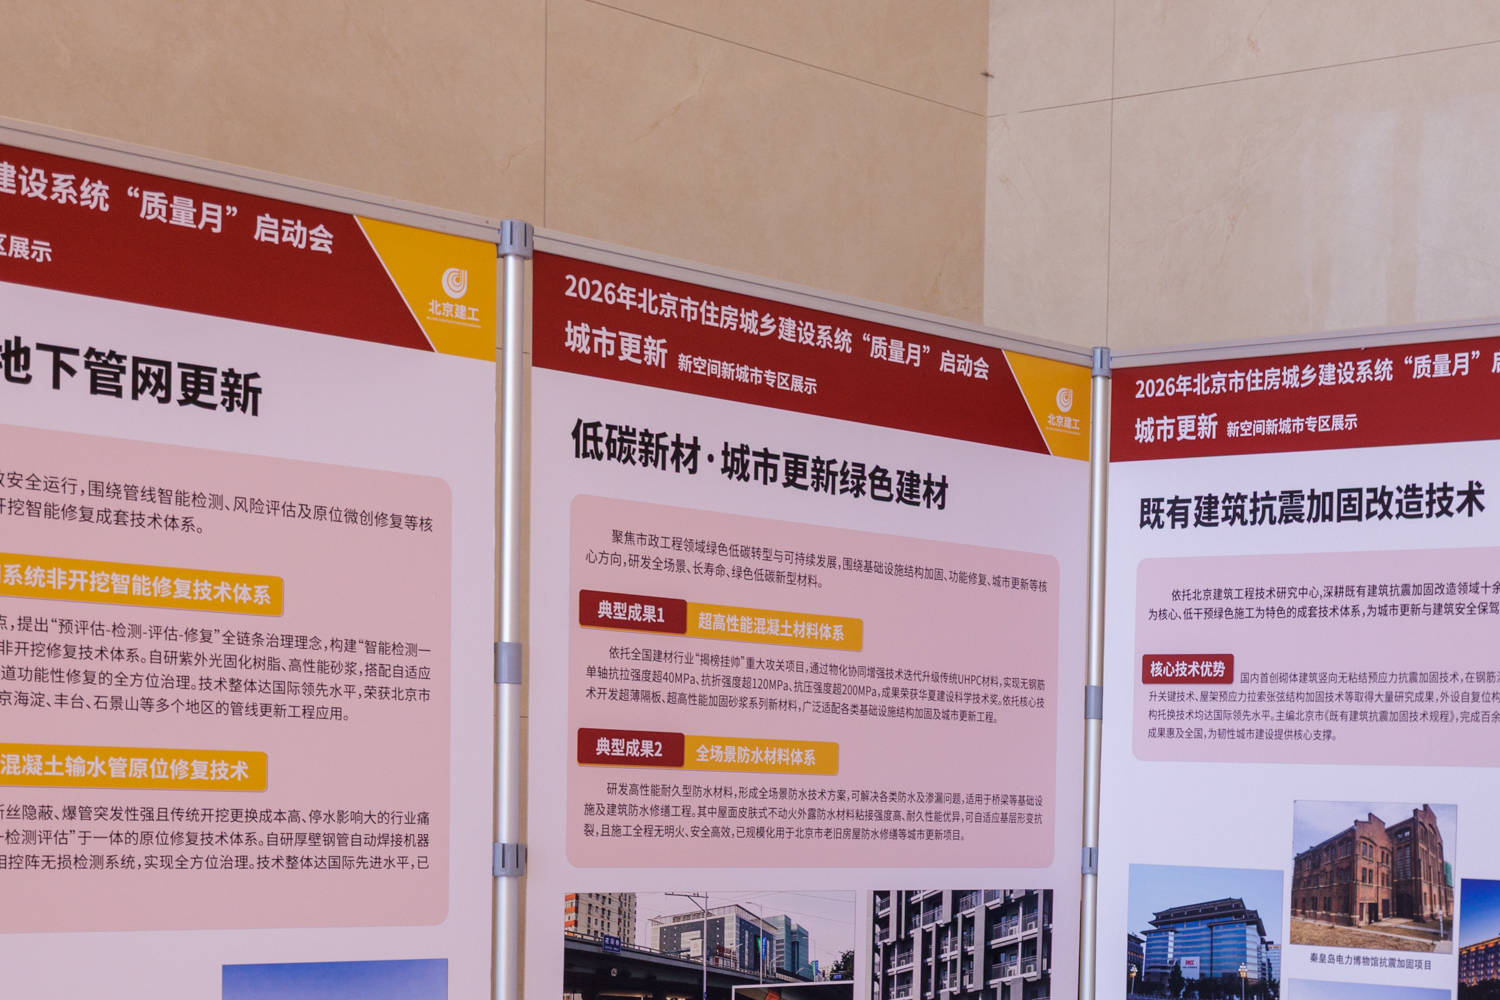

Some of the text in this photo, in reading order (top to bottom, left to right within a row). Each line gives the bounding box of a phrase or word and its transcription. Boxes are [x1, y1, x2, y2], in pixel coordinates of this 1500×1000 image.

[428, 299, 480, 322] 北京建工
[565, 274, 990, 381] 2026年北京市住房城乡建设系统“质量月”启动会
[565, 320, 818, 395] 城市更新 新空间新城市专区展示
[0, 336, 262, 416] 地下管网更新
[1047, 413, 1081, 431] 北京建工
[1135, 412, 1358, 444] 城市更新 新空间新城市专区展示
[571, 418, 948, 511] 低碳新材·城市更新绿色建材
[0, 471, 433, 533] 安全运行，围绕管线智能检测、风险评估及原位微创修复等核
[1139, 480, 1486, 531] 既有建筑抗震加固改造技术
[0, 563, 271, 606] 系统非开挖智能修复技术体系
[598, 600, 665, 623] 典型成果1
[698, 612, 844, 641] 超高性能混凝土材料体系
[1150, 660, 1226, 678] 核心技术优势
[596, 737, 663, 757] 典型成果2
[696, 744, 816, 766] 全场景防水材料体系
[1, 753, 249, 782] 混凝土输水管原位修复技术
[1310, 952, 1432, 970] 秦皇岛电力博物馆抗震加固项目
